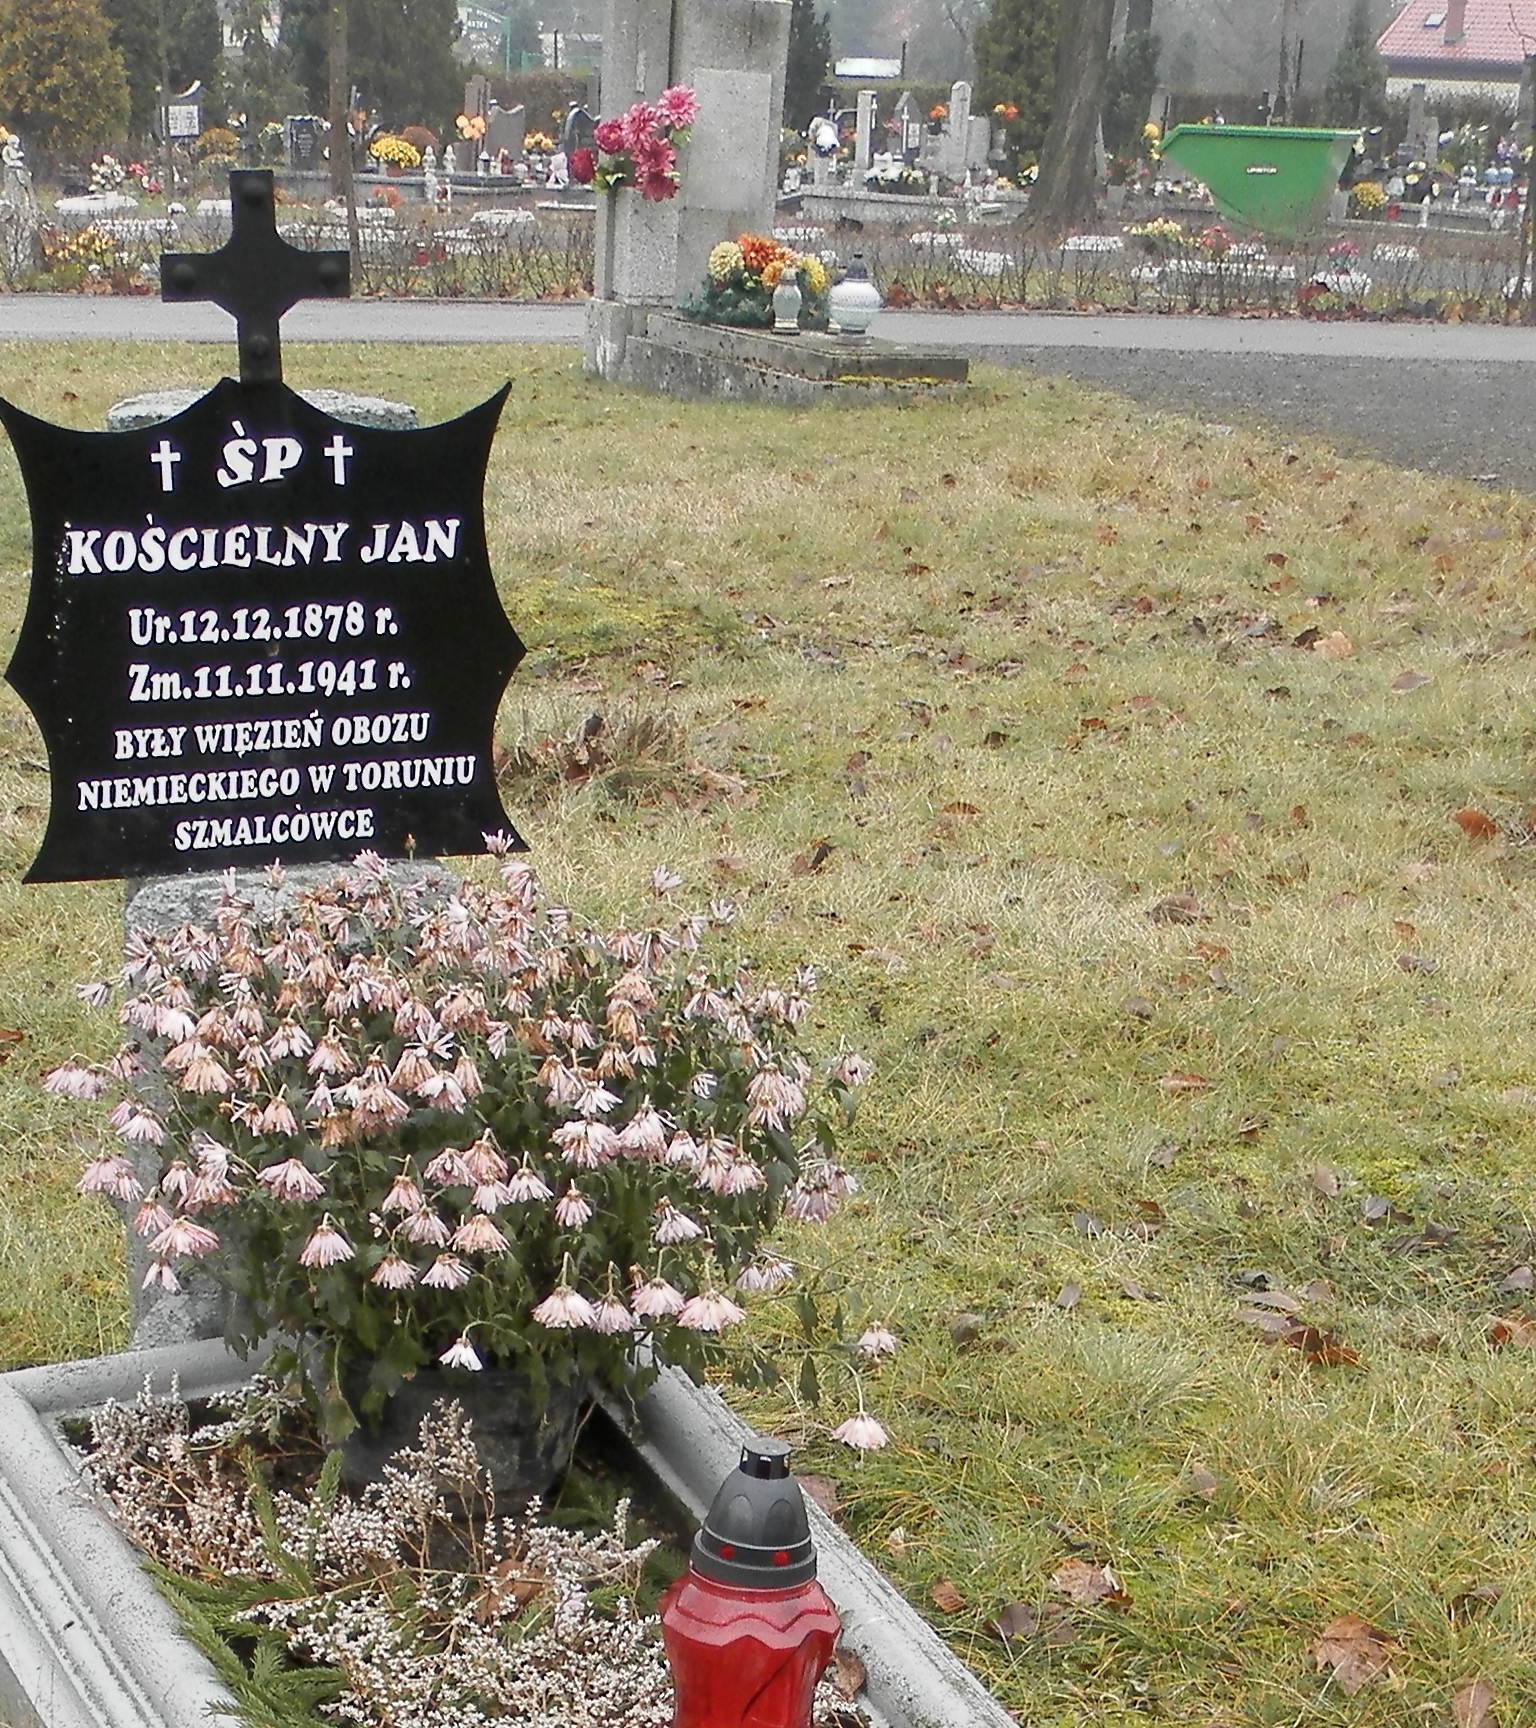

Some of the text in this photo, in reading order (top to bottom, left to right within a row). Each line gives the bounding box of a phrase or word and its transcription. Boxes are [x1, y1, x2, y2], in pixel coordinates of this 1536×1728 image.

[65, 513, 461, 575] KOŚCIELNY JAN
[128, 600, 399, 646] Ur.12.12.1878 r.
[128, 658, 411, 702] Zm.11.11.1941 r.
[114, 708, 431, 760] BYŁY WIĘZIEŃ OBOZU
[77, 755, 477, 811] NIEMIECKIEGO W TORUNIU
